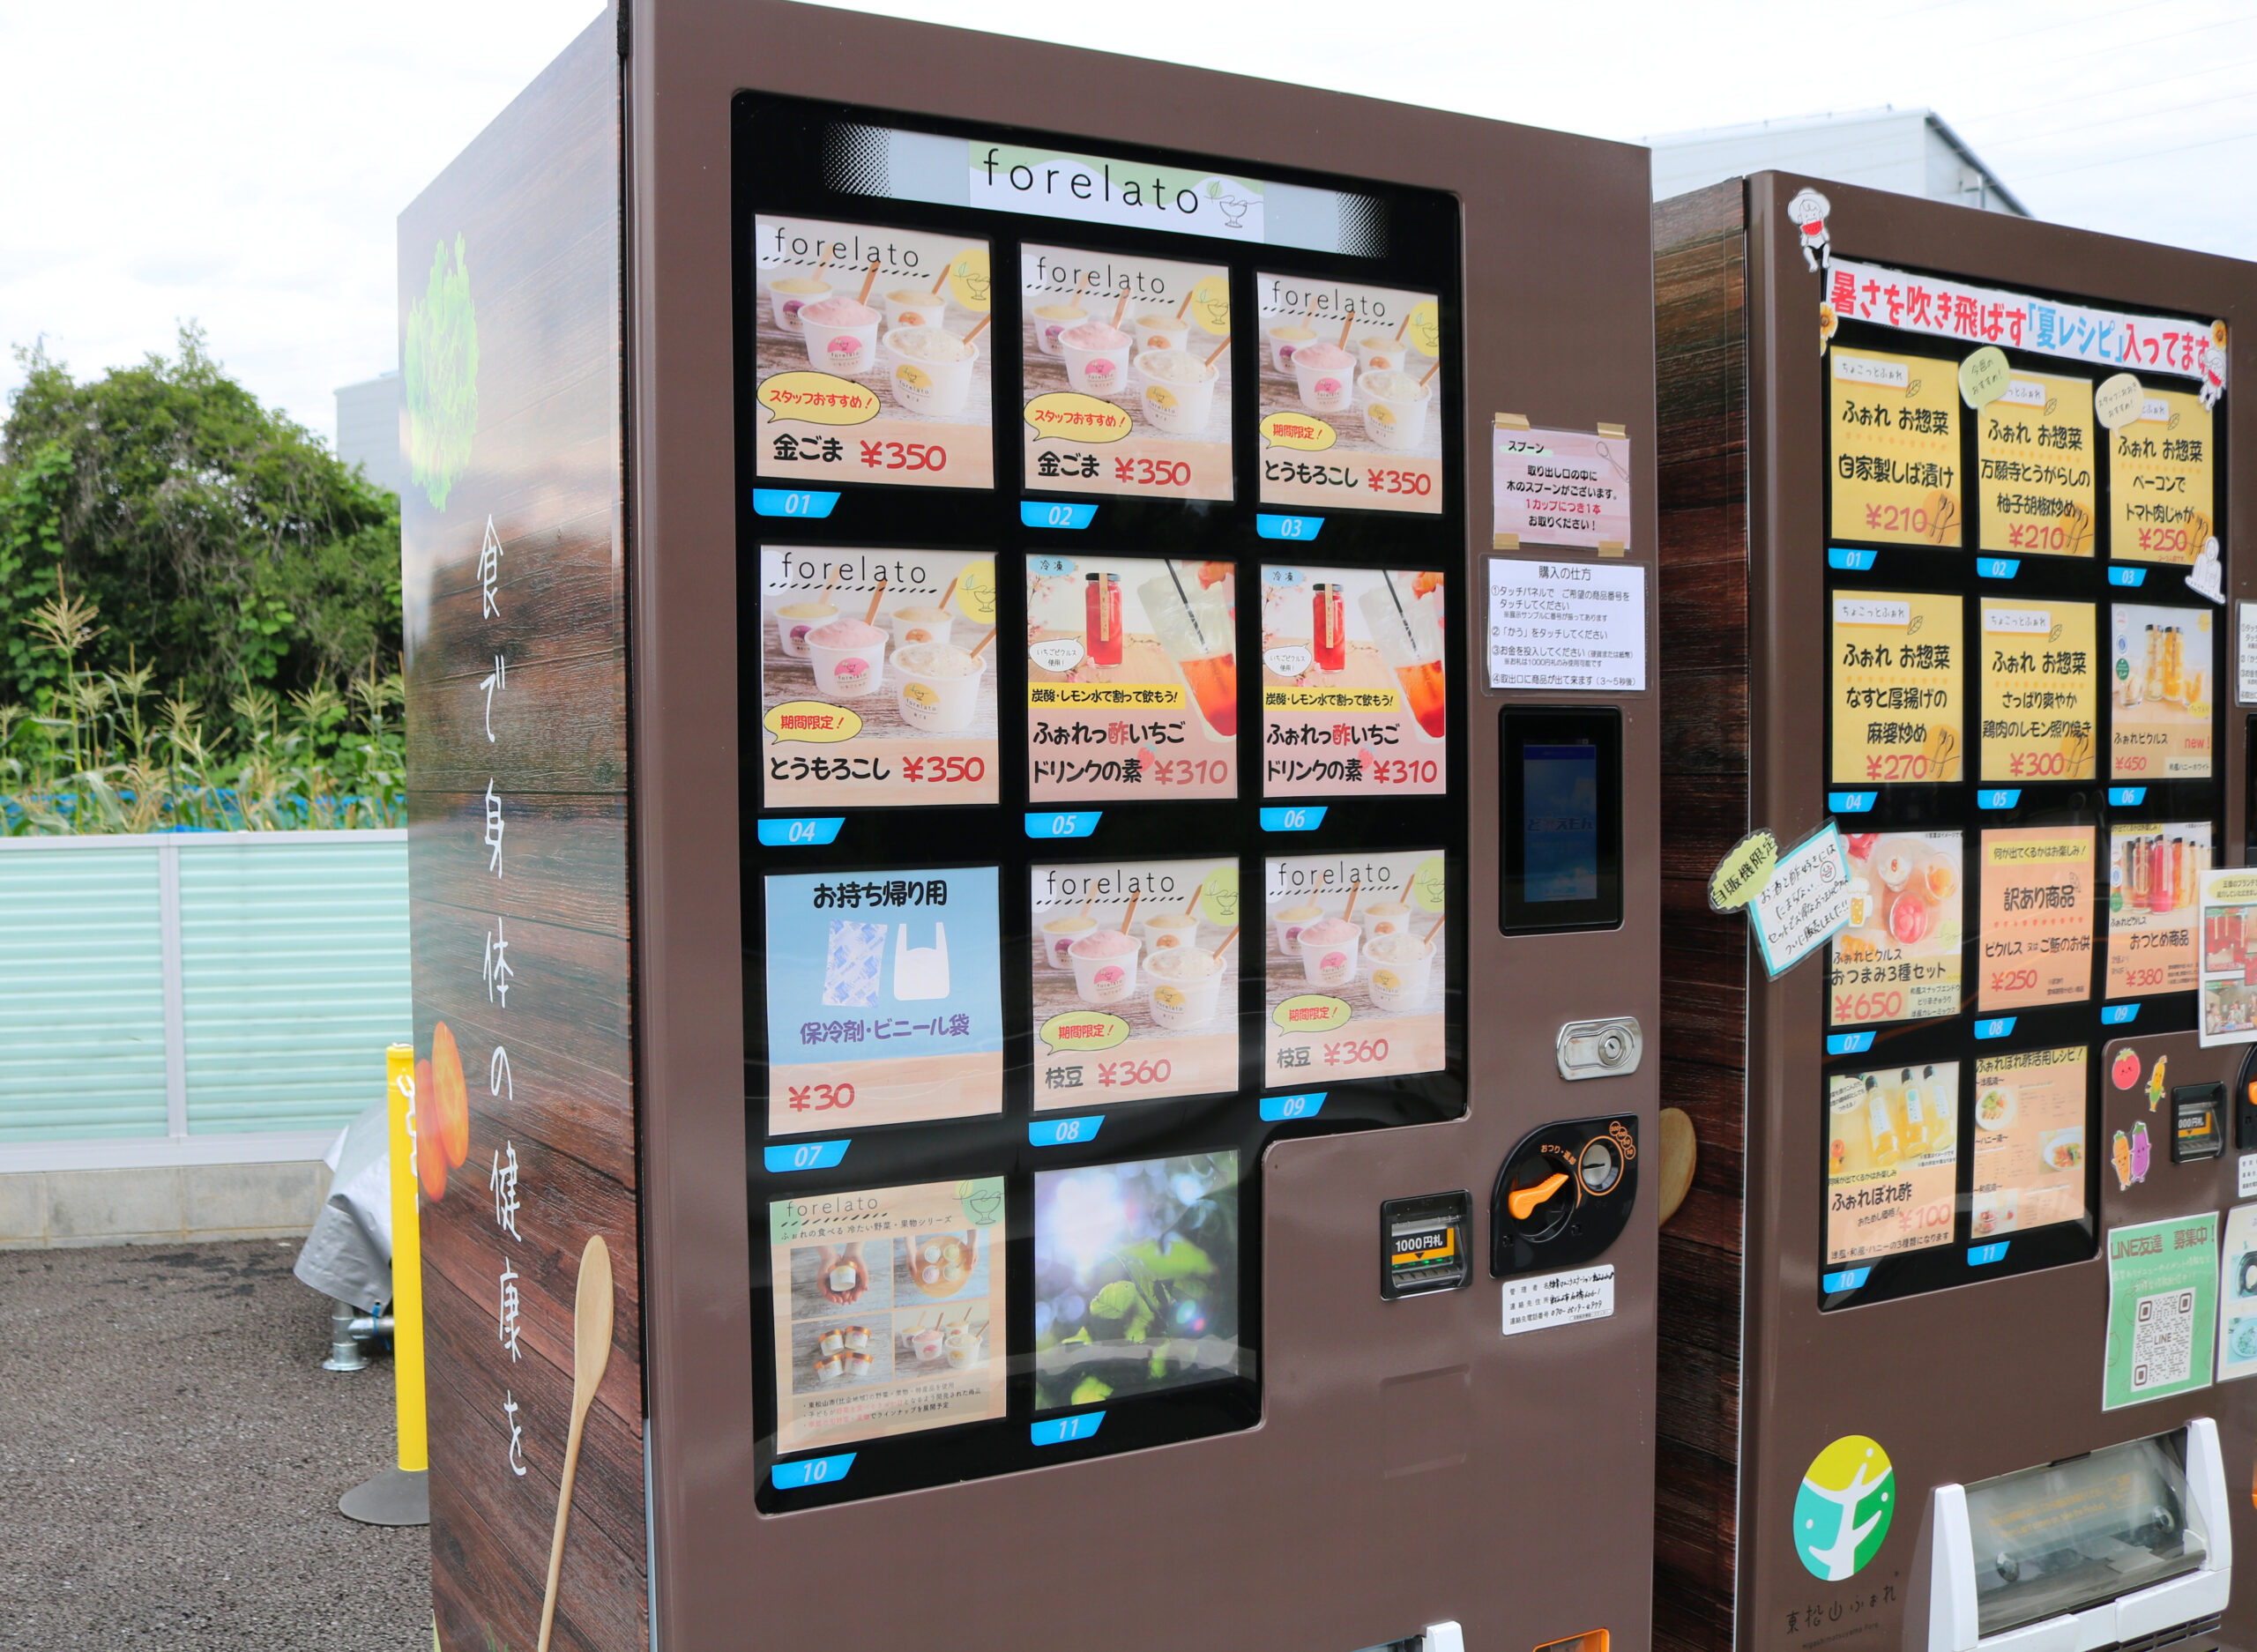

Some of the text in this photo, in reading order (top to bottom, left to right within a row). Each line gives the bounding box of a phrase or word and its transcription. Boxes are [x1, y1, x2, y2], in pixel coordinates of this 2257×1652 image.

[983, 148, 1198, 214] forelato
[775, 227, 919, 266] forelato
[1037, 257, 1165, 294] forelato
[1272, 281, 1386, 317] forelato
[770, 390, 872, 409] スタッフおすすめ！
[1035, 410, 1126, 428] スタッフおすすめ！
[1843, 400, 1948, 435] ふぉれ お惣菜
[1273, 423, 1322, 441] 期間限定！
[1987, 420, 2082, 451] ふぉれ お惣菜
[773, 434, 947, 472] 金ごま ¥350
[1508, 441, 1544, 453] スプーン
[2118, 435, 2202, 463] ふぉれ お惣菜
[1038, 451, 1191, 486] 金ごま ¥350
[1265, 460, 1432, 495] とうもろこし ¥350
[1528, 465, 1598, 480] 取り出し口の中に
[1839, 454, 1954, 488] 自家製しば漬け
[1981, 458, 2090, 487] 万願寺とうがらしの
[1507, 481, 1617, 500] 木のスプーンがございます。
[2134, 476, 2186, 493] ベーコンで
[785, 494, 810, 515] 01
[1526, 499, 1601, 515] 1カップにつき1本
[1997, 493, 2076, 517] 柚子胡椒炒め
[2126, 503, 2195, 525] トマト肉じゃが
[1048, 506, 1073, 525] 02
[1529, 516, 1596, 531] お取りください！
[1866, 503, 1927, 532] ¥210
[1281, 519, 1302, 537] 03
[2008, 522, 2065, 550] ¥210
[2138, 527, 2188, 552] ¥250
[782, 552, 927, 584] forelato
[1846, 552, 1861, 567] 01
[1993, 562, 2007, 577] 02
[1538, 565, 1591, 581] 購入の仕方
[2121, 569, 2135, 584] 03
[1500, 599, 1569, 610] タッチしてください
[1844, 644, 1950, 669] ふぉれ お惣菜
[1992, 651, 2087, 674] ふぉれ お惣菜
[1846, 688, 1948, 709] なすと厚揚げの
[2002, 692, 2077, 709] さっぱり爽やか
[780, 715, 845, 731] 期間限定！
[1033, 721, 1186, 745] ふぉれっ酢いちご
[1867, 722, 1927, 744] 麻婆炒め
[1983, 719, 2091, 739] 鶏肉のレモン照り焼き
[1267, 723, 1401, 746] ふぉれっ酢いちご
[2114, 733, 2168, 745] ふぉれピクルス
[771, 755, 985, 783] とうもろこし ¥350
[1034, 759, 1228, 785] ドリンクの素 ¥310
[1268, 758, 1437, 784] ドリンクの素 ¥310
[1866, 755, 1927, 781] ¥270
[2009, 752, 2065, 777] ¥300
[2116, 756, 2147, 771] ¥450
[1846, 794, 1862, 810] 04
[1993, 792, 2007, 807] 05
[2121, 789, 2134, 804] 06
[1052, 815, 1076, 835] 05
[1285, 810, 1306, 828] 06
[788, 822, 816, 842] 04
[1993, 845, 2087, 860] 何が出てくるかはお楽しみ！
[1278, 861, 1390, 886] forelato
[1711, 836, 1776, 906] 自販機限定
[1047, 870, 1174, 895] forelato
[814, 881, 947, 909] お持ち帰り用
[2004, 884, 2075, 912] 訳あり商品
[1985, 941, 2022, 957] ピクルス
[2040, 935, 2090, 954] ご飯のお供
[2130, 929, 2189, 950] おつとめ商品
[1834, 949, 1903, 964] ふぉれピクルス
[1831, 962, 1946, 986] おつまみ3種セット
[1992, 969, 2037, 992] ¥250
[2127, 968, 2164, 987] ¥380
[477, 514, 526, 1477] 食で身体の健康を
[1289, 1007, 1338, 1022] 期間限定！
[1835, 991, 1903, 1023] ¥650
[2114, 1008, 2128, 1021] 09
[801, 1014, 970, 1045] 保冷剤・ビニール袋
[1058, 1023, 1114, 1039] 期間限定！
[1989, 1021, 2003, 1036] 08
[1277, 1038, 1389, 1068] 枝豆 ¥360
[1844, 1035, 1860, 1051] 07
[1046, 1059, 1171, 1089] 枝豆 ¥360
[788, 1083, 855, 1112] ¥30
[1284, 1098, 1305, 1116] 09
[1056, 1121, 1079, 1141] 08
[794, 1145, 823, 1167] 07
[786, 1196, 877, 1217] forelato
[1898, 1202, 1951, 1232] ¥100
[1396, 1234, 1442, 1252] 1000円札
[2111, 1224, 2215, 1260] LINE友達 募集中！
[1983, 1246, 1995, 1261] 11
[1840, 1272, 1854, 1288] 10
[2154, 1333, 2171, 1345] LINE
[1059, 1418, 1079, 1439] 11
[803, 1461, 827, 1483] 10
